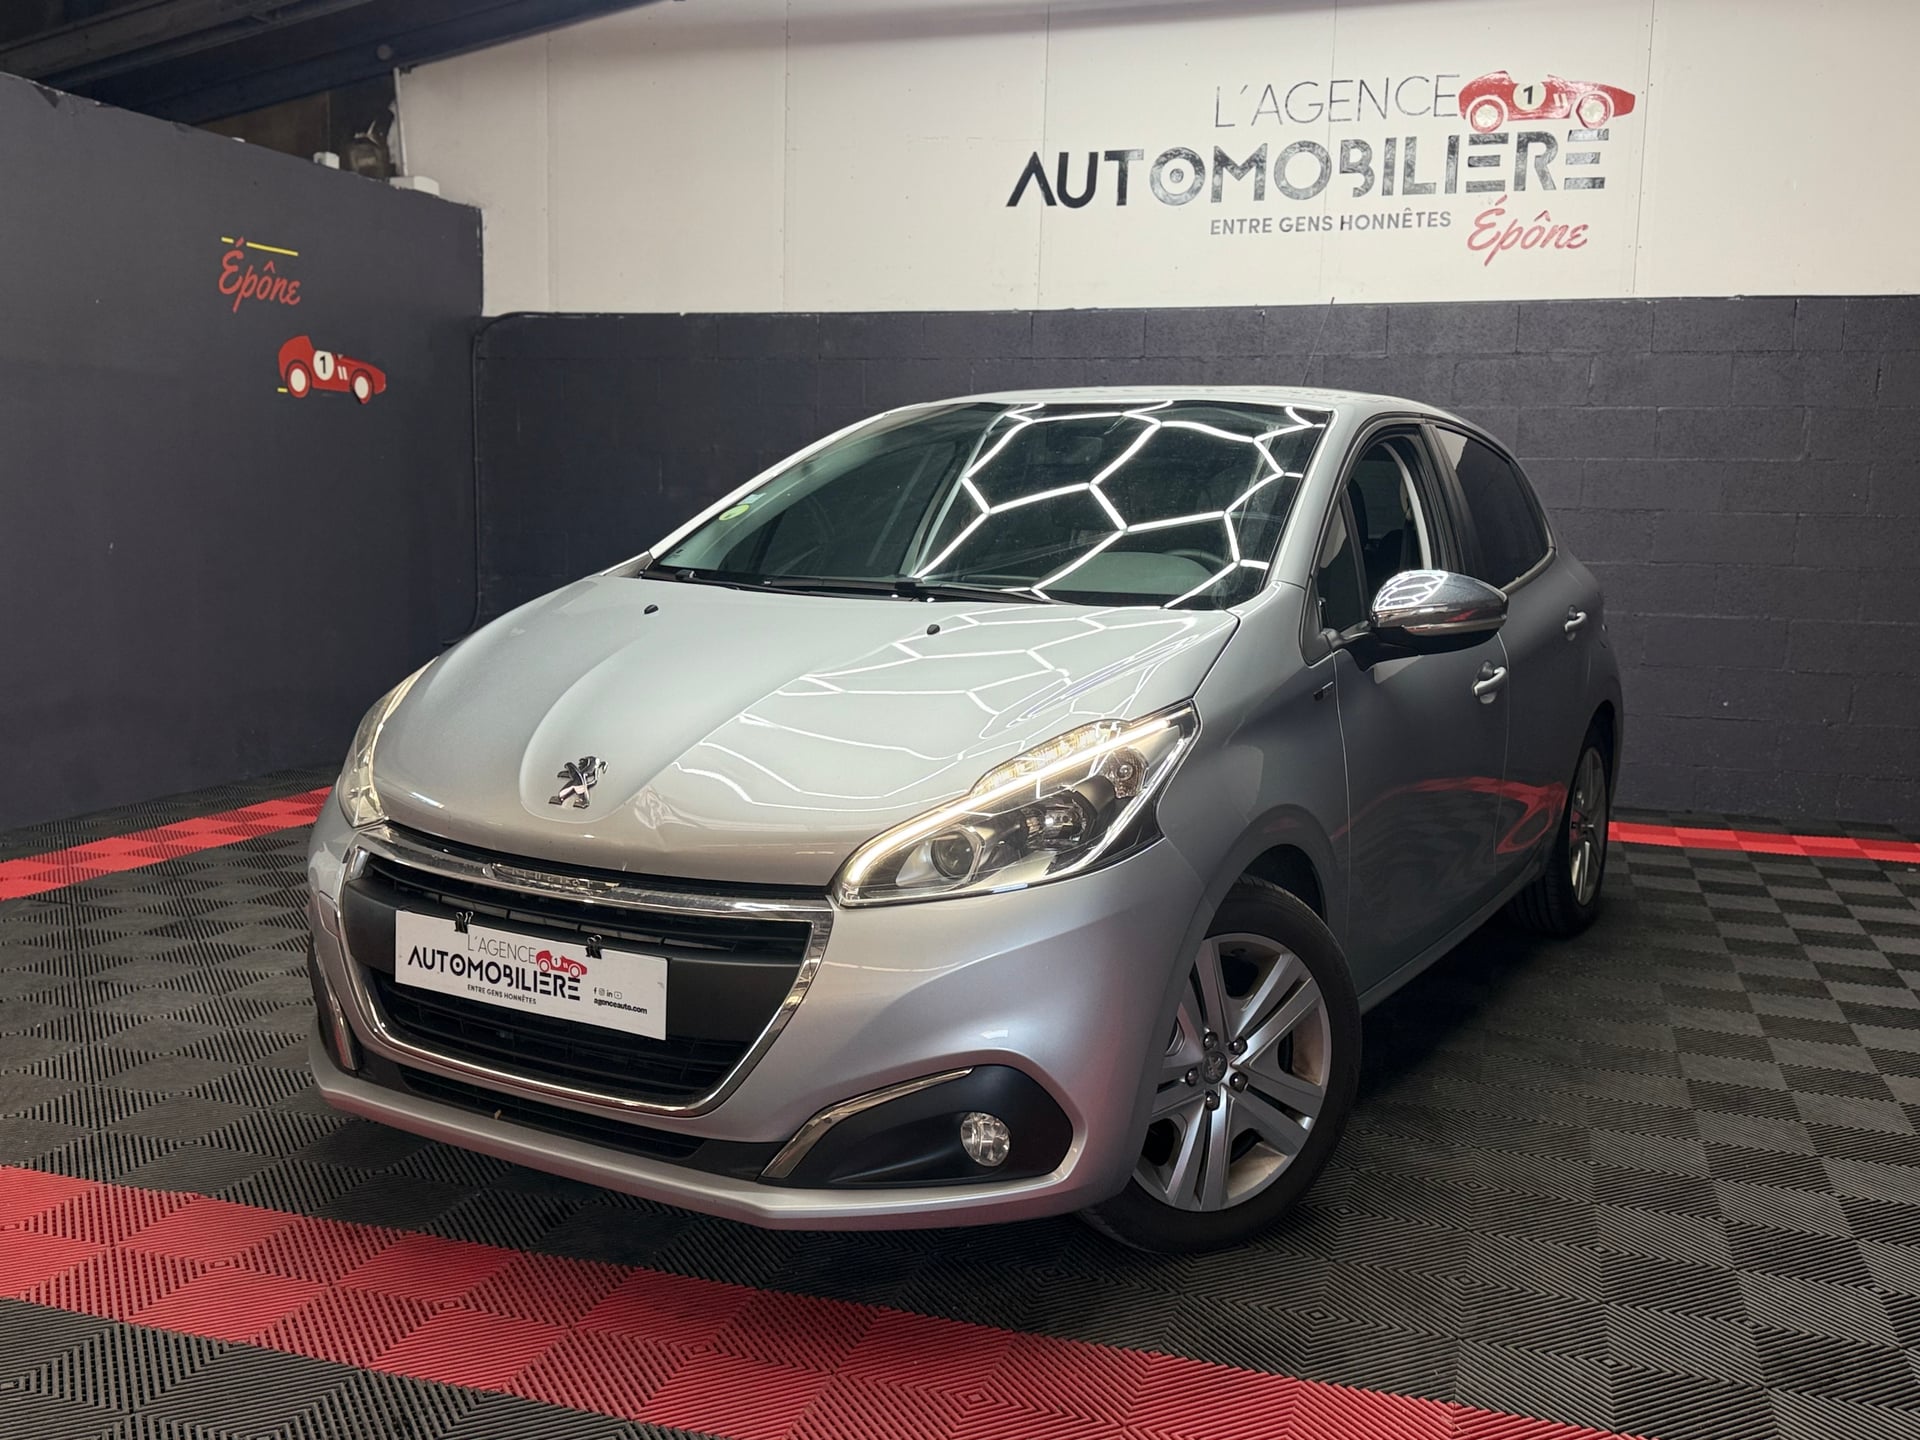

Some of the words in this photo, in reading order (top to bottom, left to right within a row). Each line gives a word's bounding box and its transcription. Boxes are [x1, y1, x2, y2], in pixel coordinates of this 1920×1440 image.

[1215, 74, 1461, 128] L'AGENCE
[1523, 86, 1534, 104] 1
[1210, 217, 1273, 235] ENTRE
[1279, 215, 1333, 233] GENS
[1340, 207, 1452, 231] HONNÊTES
[1467, 195, 1588, 267] Épône
[218, 236, 301, 313] Épône
[319, 355, 327, 374] 1
[467, 934, 537, 965] L'AGENCE
[467, 984, 486, 994] ENTRE
[486, 988, 503, 998] GENS
[503, 993, 537, 1005] HONNÊTES
[593, 998, 648, 1015] agenceauto.com
